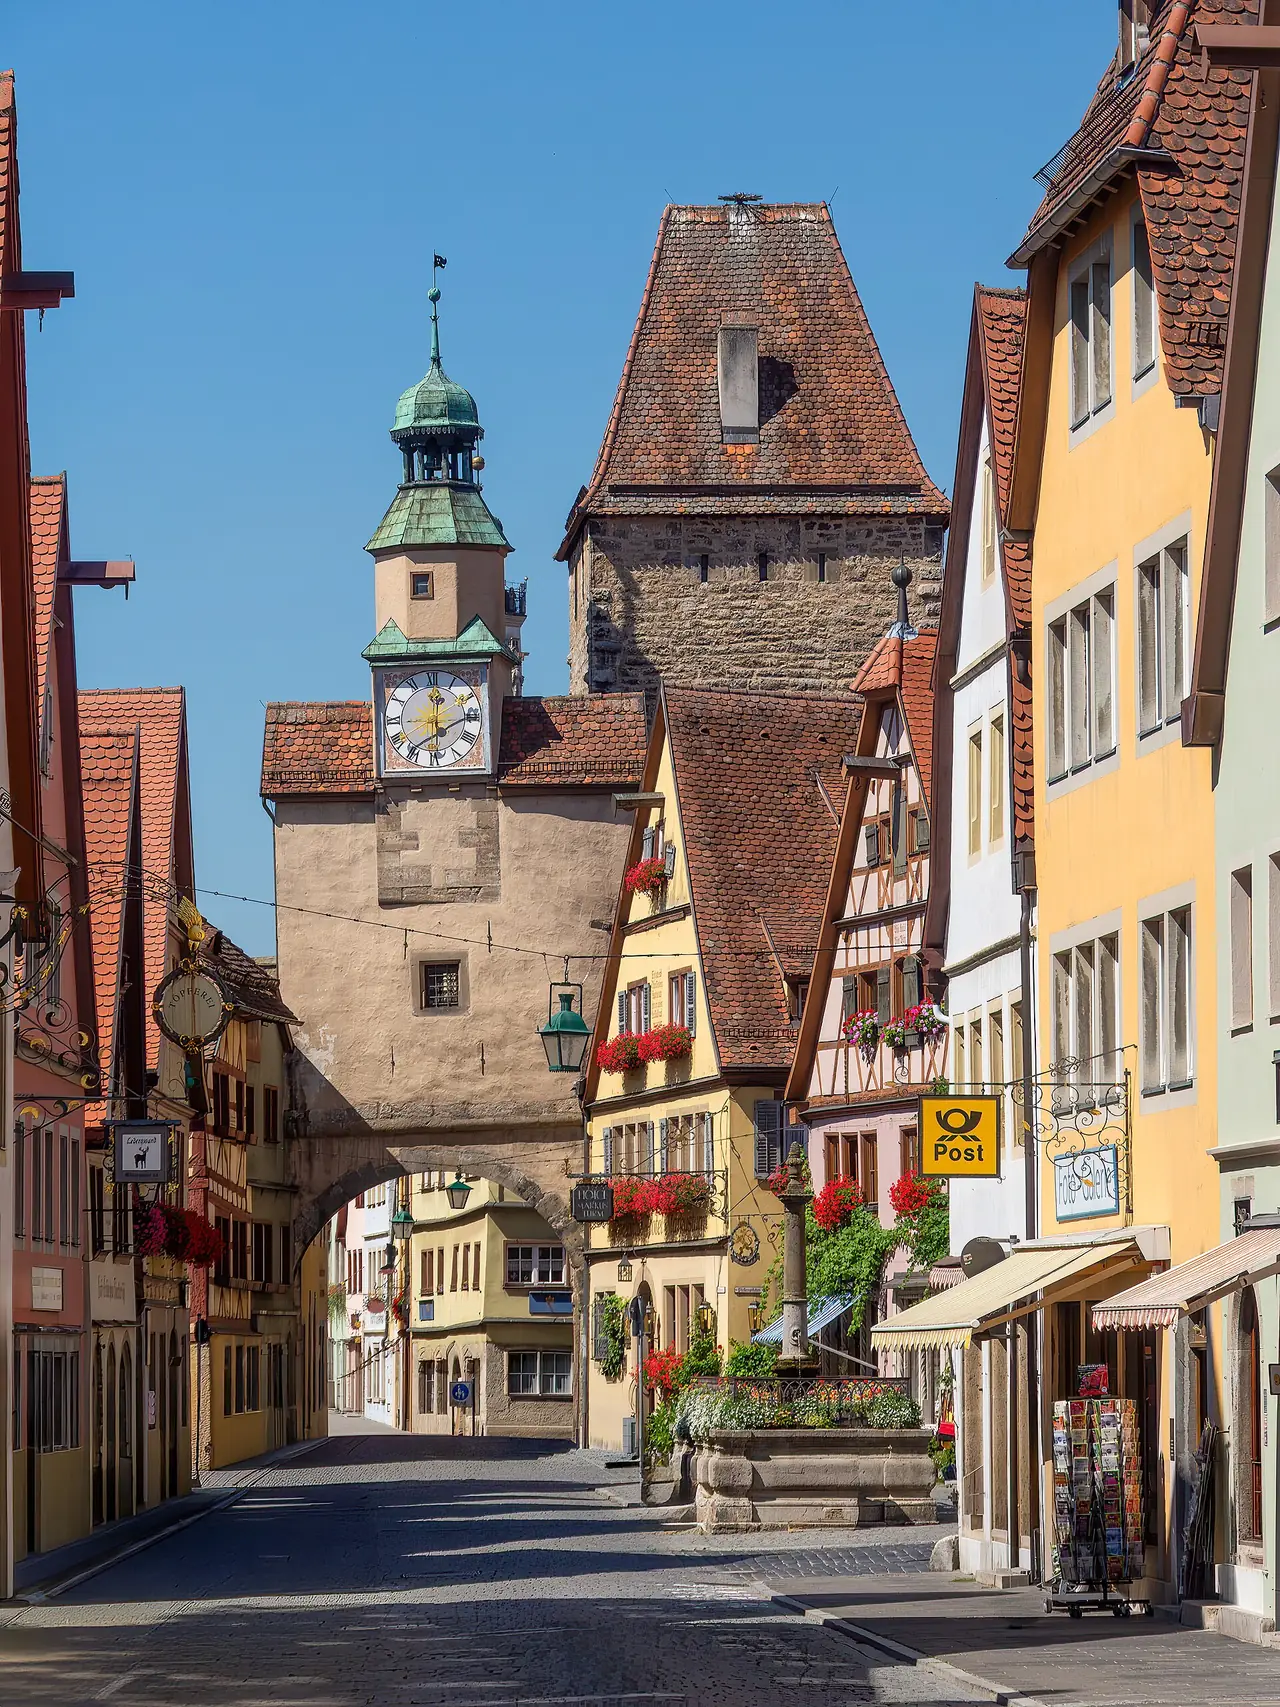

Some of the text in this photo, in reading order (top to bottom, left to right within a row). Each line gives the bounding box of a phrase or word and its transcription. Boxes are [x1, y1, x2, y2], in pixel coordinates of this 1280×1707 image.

[426, 672, 438, 686] XII
[448, 677, 457, 690] I
[391, 693, 406, 706] X
[386, 715, 401, 726] IX
[460, 730, 477, 747] IIII
[406, 746, 421, 764] VII
[450, 746, 462, 761] V
[934, 1143, 984, 1161] Post
